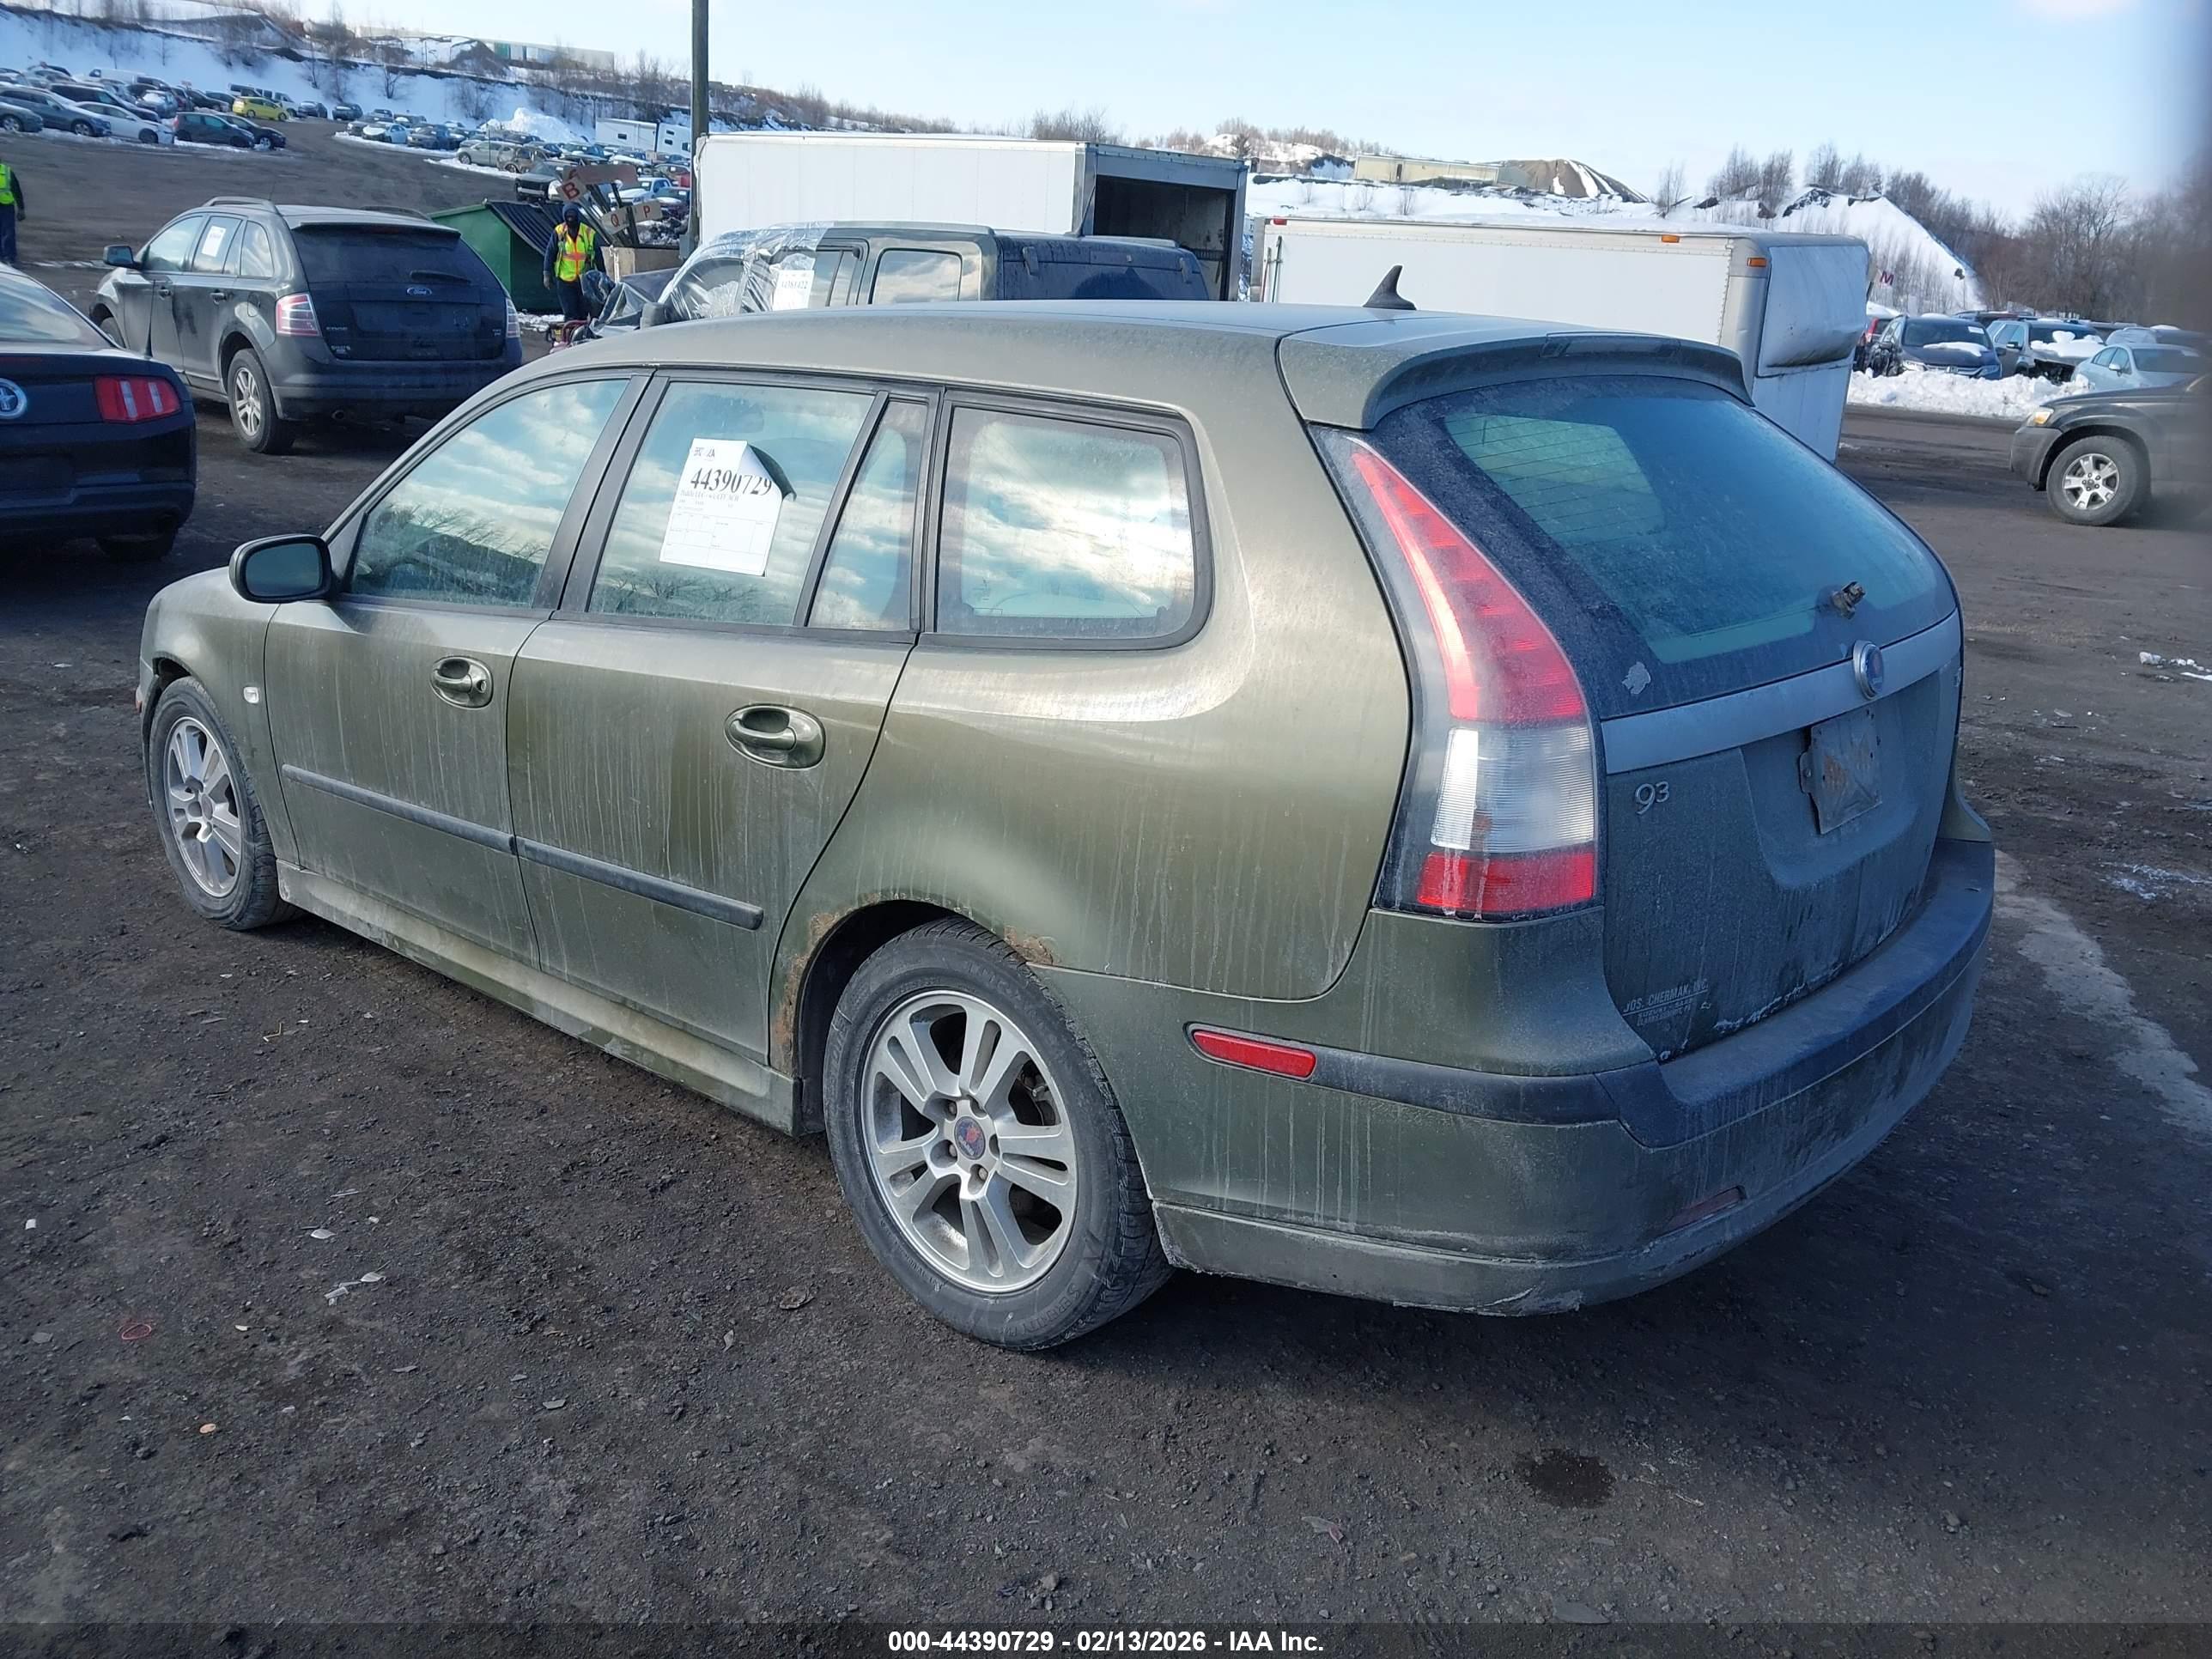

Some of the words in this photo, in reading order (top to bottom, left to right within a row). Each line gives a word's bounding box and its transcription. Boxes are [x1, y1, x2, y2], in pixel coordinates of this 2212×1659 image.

[562, 182, 580, 200] B
[643, 205, 651, 217] P
[611, 214, 620, 227] Q
[1880, 270, 1894, 286] M
[690, 467, 772, 495] 44390729
[1623, 998, 1644, 1012] JOS.
[1648, 983, 1691, 1006] CHERMAK,
